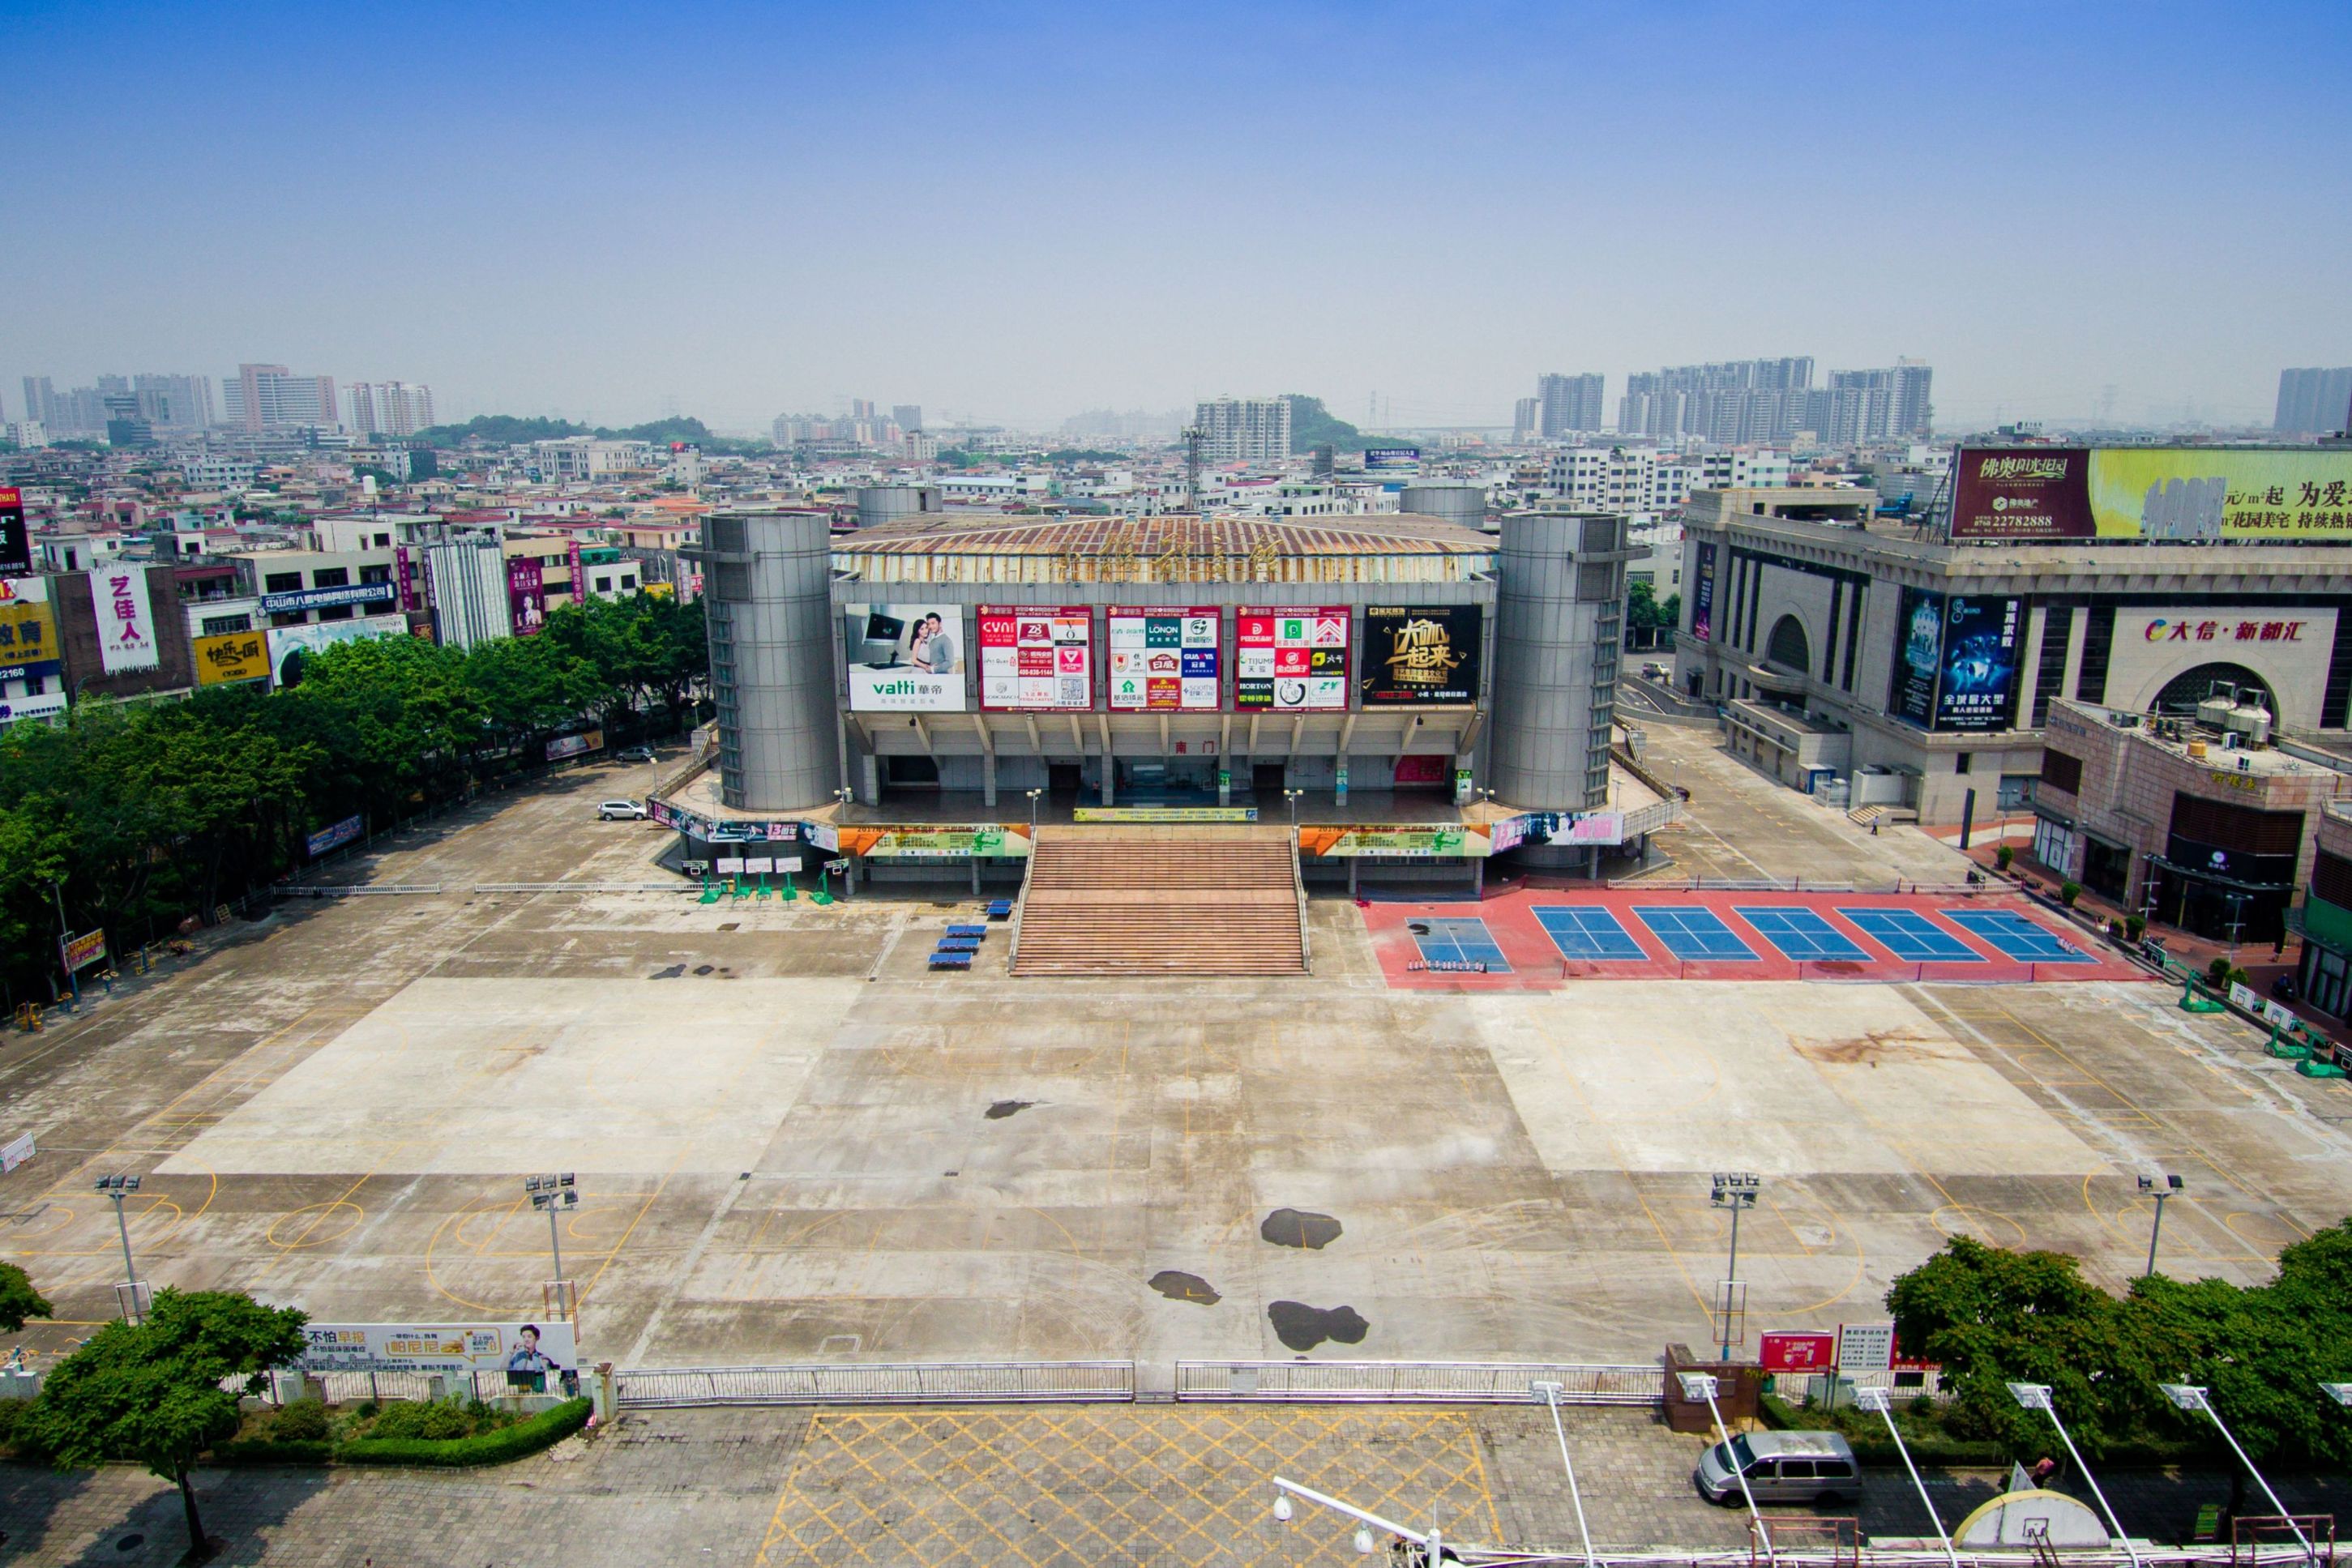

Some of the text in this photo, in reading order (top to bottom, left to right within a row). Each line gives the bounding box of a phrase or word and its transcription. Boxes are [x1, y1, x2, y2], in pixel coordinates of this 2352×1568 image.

[1979, 457, 2068, 478] 佛奥阳光花园
[2295, 481, 2352, 507] 为爱
[1992, 515, 2053, 527] 22782888
[109, 575, 141, 641] 艺佳人
[873, 681, 915, 694] vatti
[1944, 694, 2004, 705] 全城最大型
[1176, 741, 1215, 754] 南门
[391, 1340, 439, 1353] 帕尼尼
